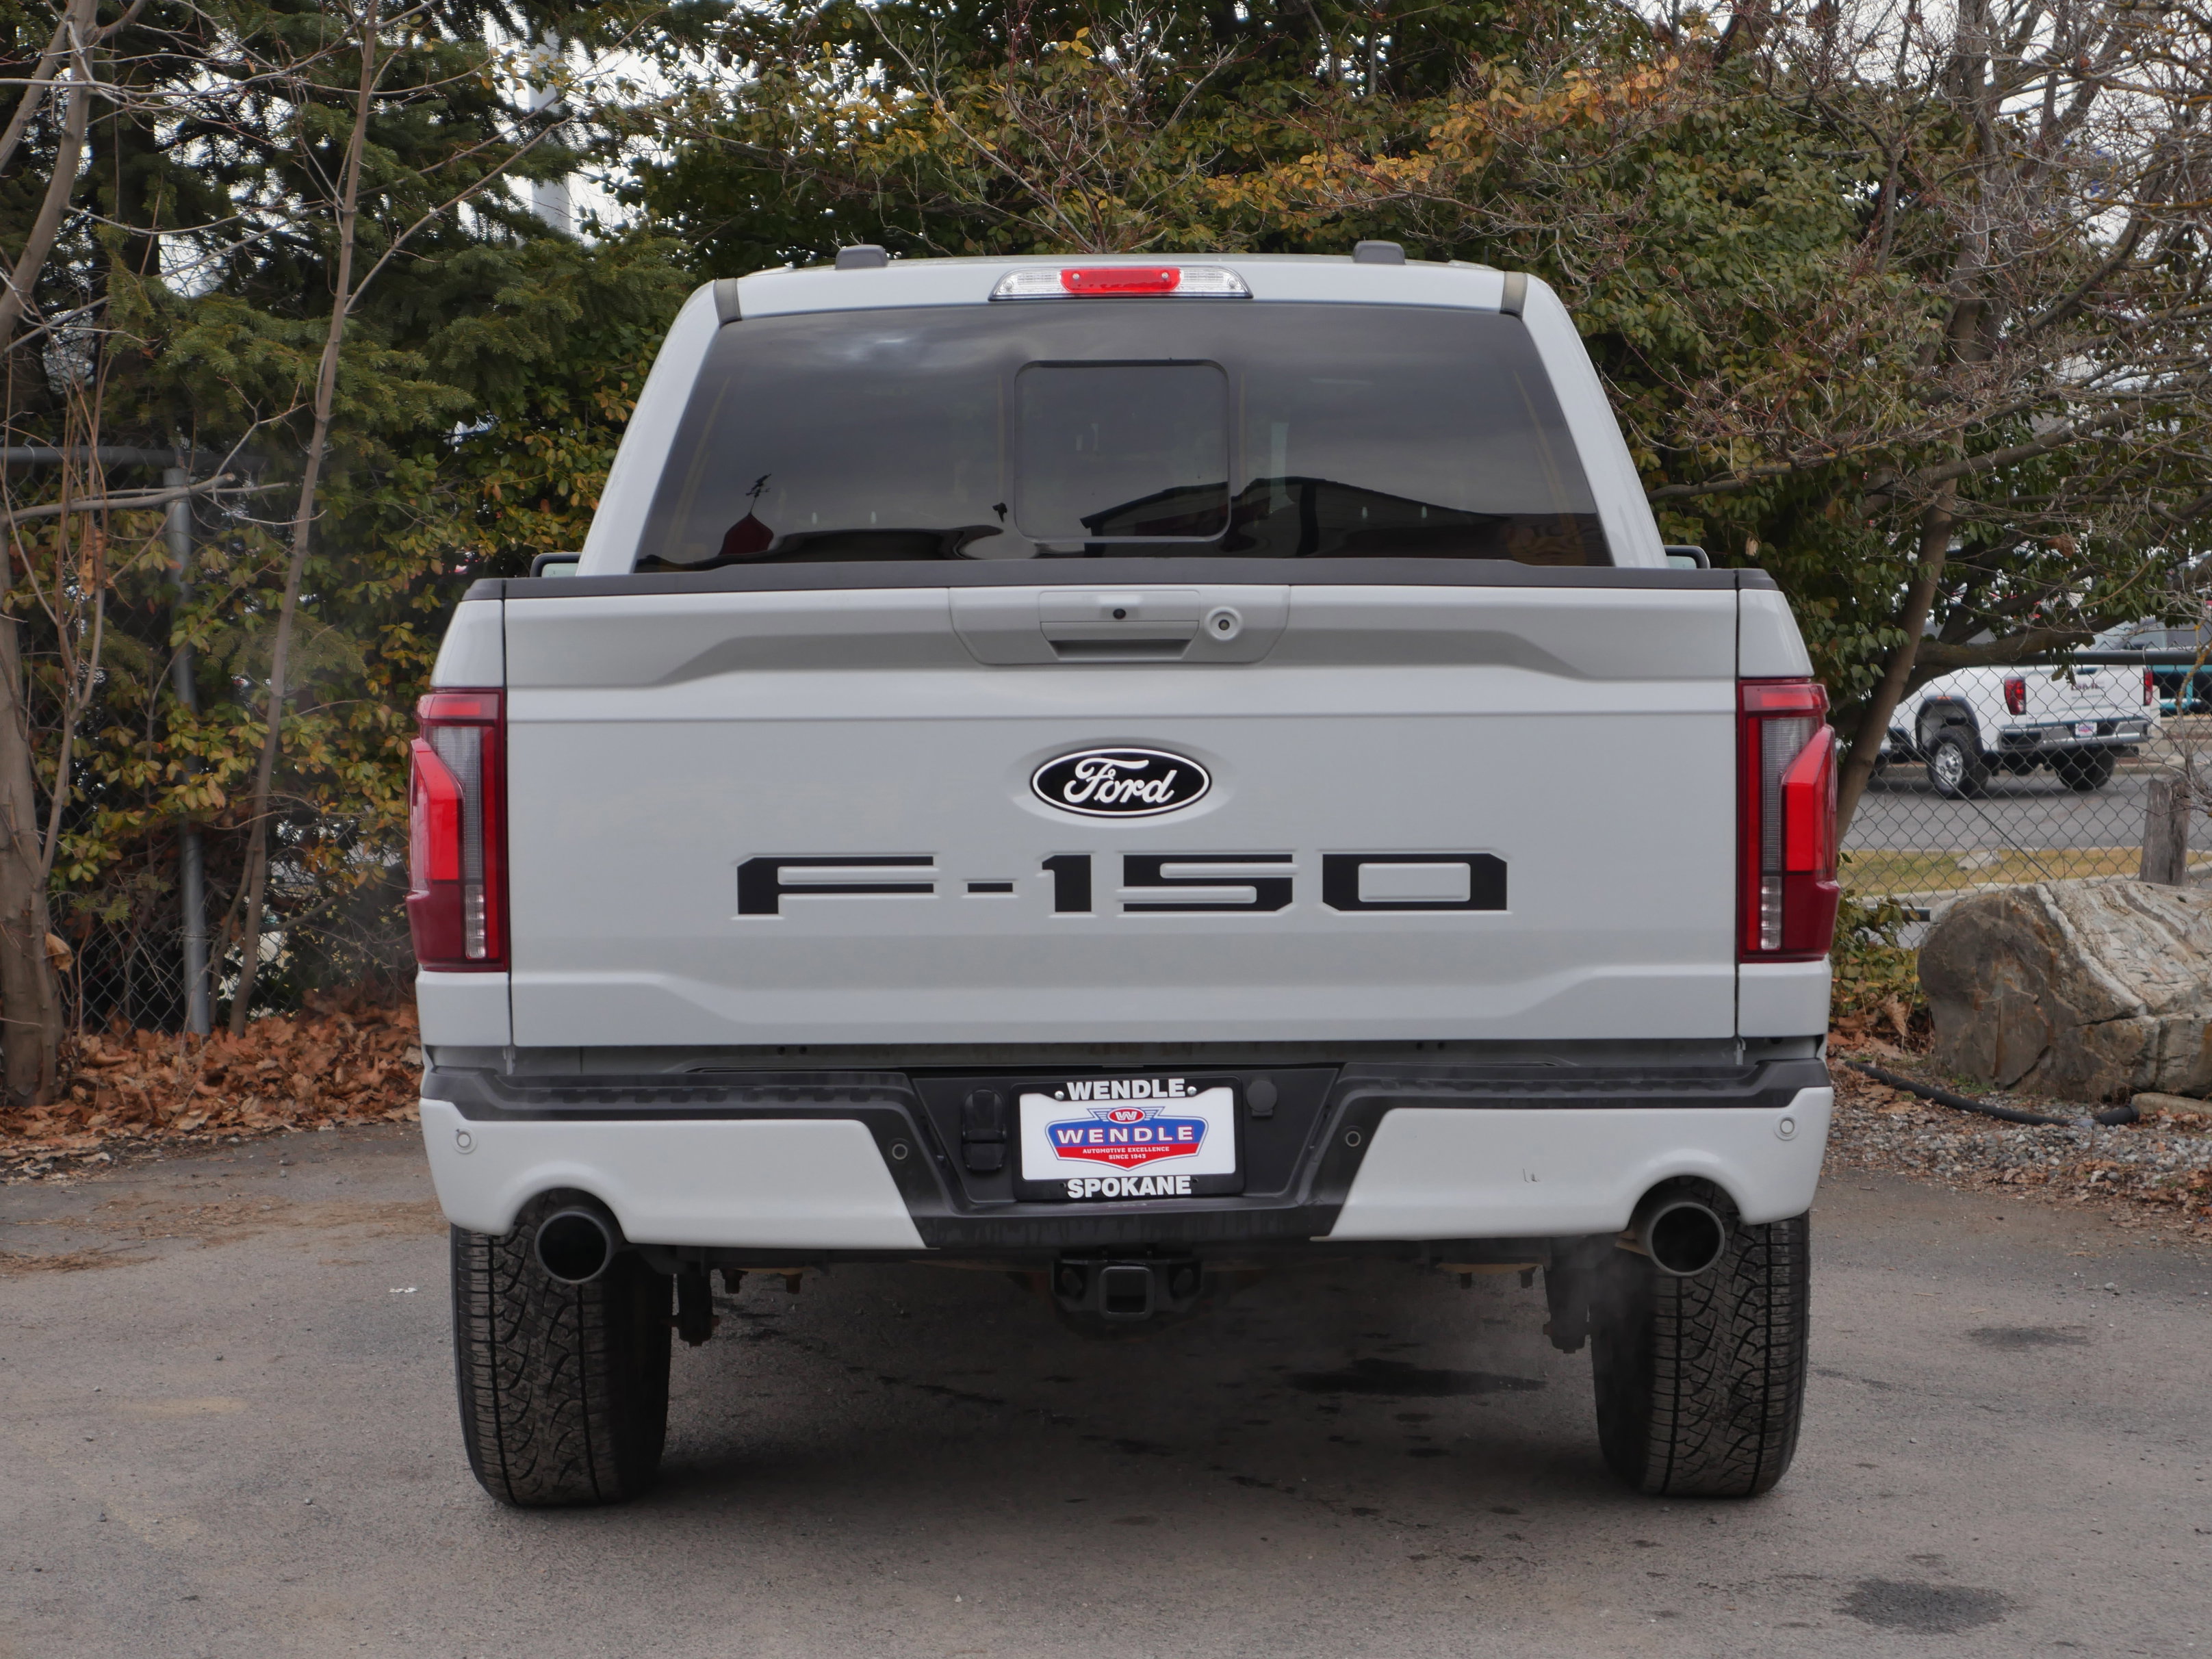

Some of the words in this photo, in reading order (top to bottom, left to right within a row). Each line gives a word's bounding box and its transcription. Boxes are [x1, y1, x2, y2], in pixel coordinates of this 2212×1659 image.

[1064, 758, 1177, 803] Ford
[737, 853, 1508, 914] F-150
[1066, 1079, 1186, 1101] WENDLE
[1057, 1126, 1193, 1144] WENDLE
[1067, 1175, 1192, 1198] SPOKANE
